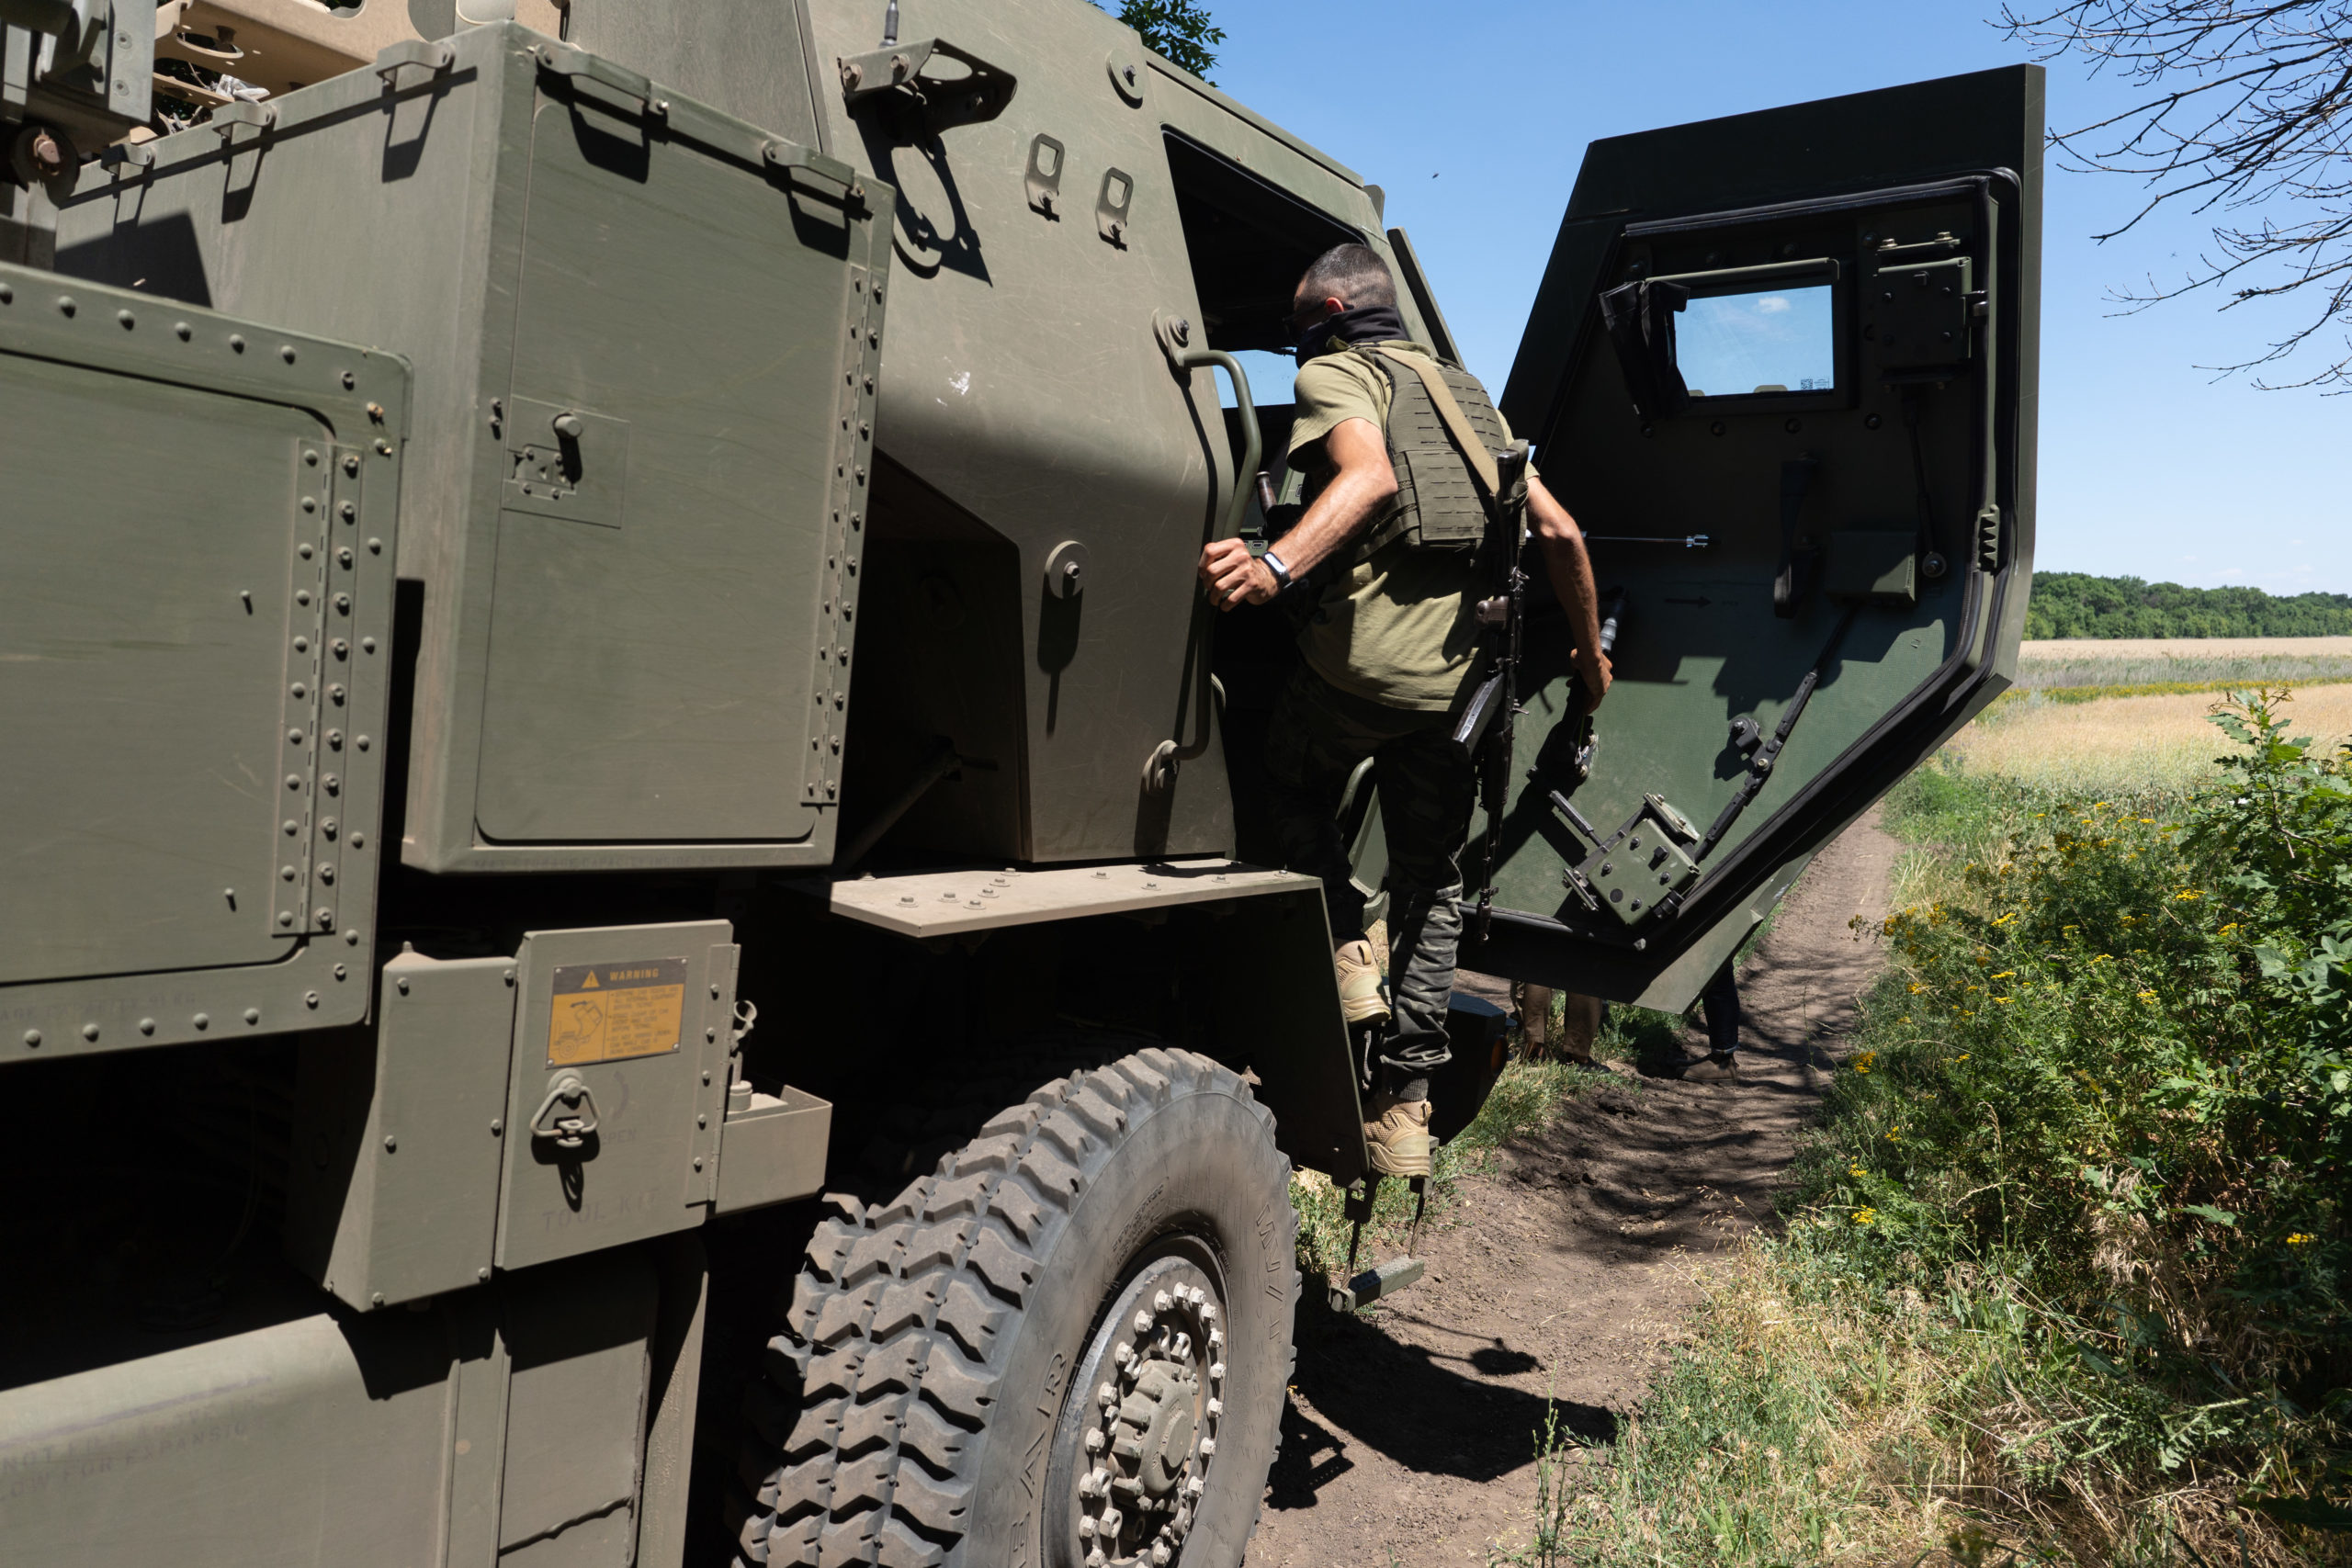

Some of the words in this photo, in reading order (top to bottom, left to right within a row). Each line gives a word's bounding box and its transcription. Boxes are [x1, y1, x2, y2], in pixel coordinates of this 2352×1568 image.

[609, 967, 660, 982] WARNING
[541, 1201, 607, 1234] TOOL
[619, 1188, 660, 1213] KIT
